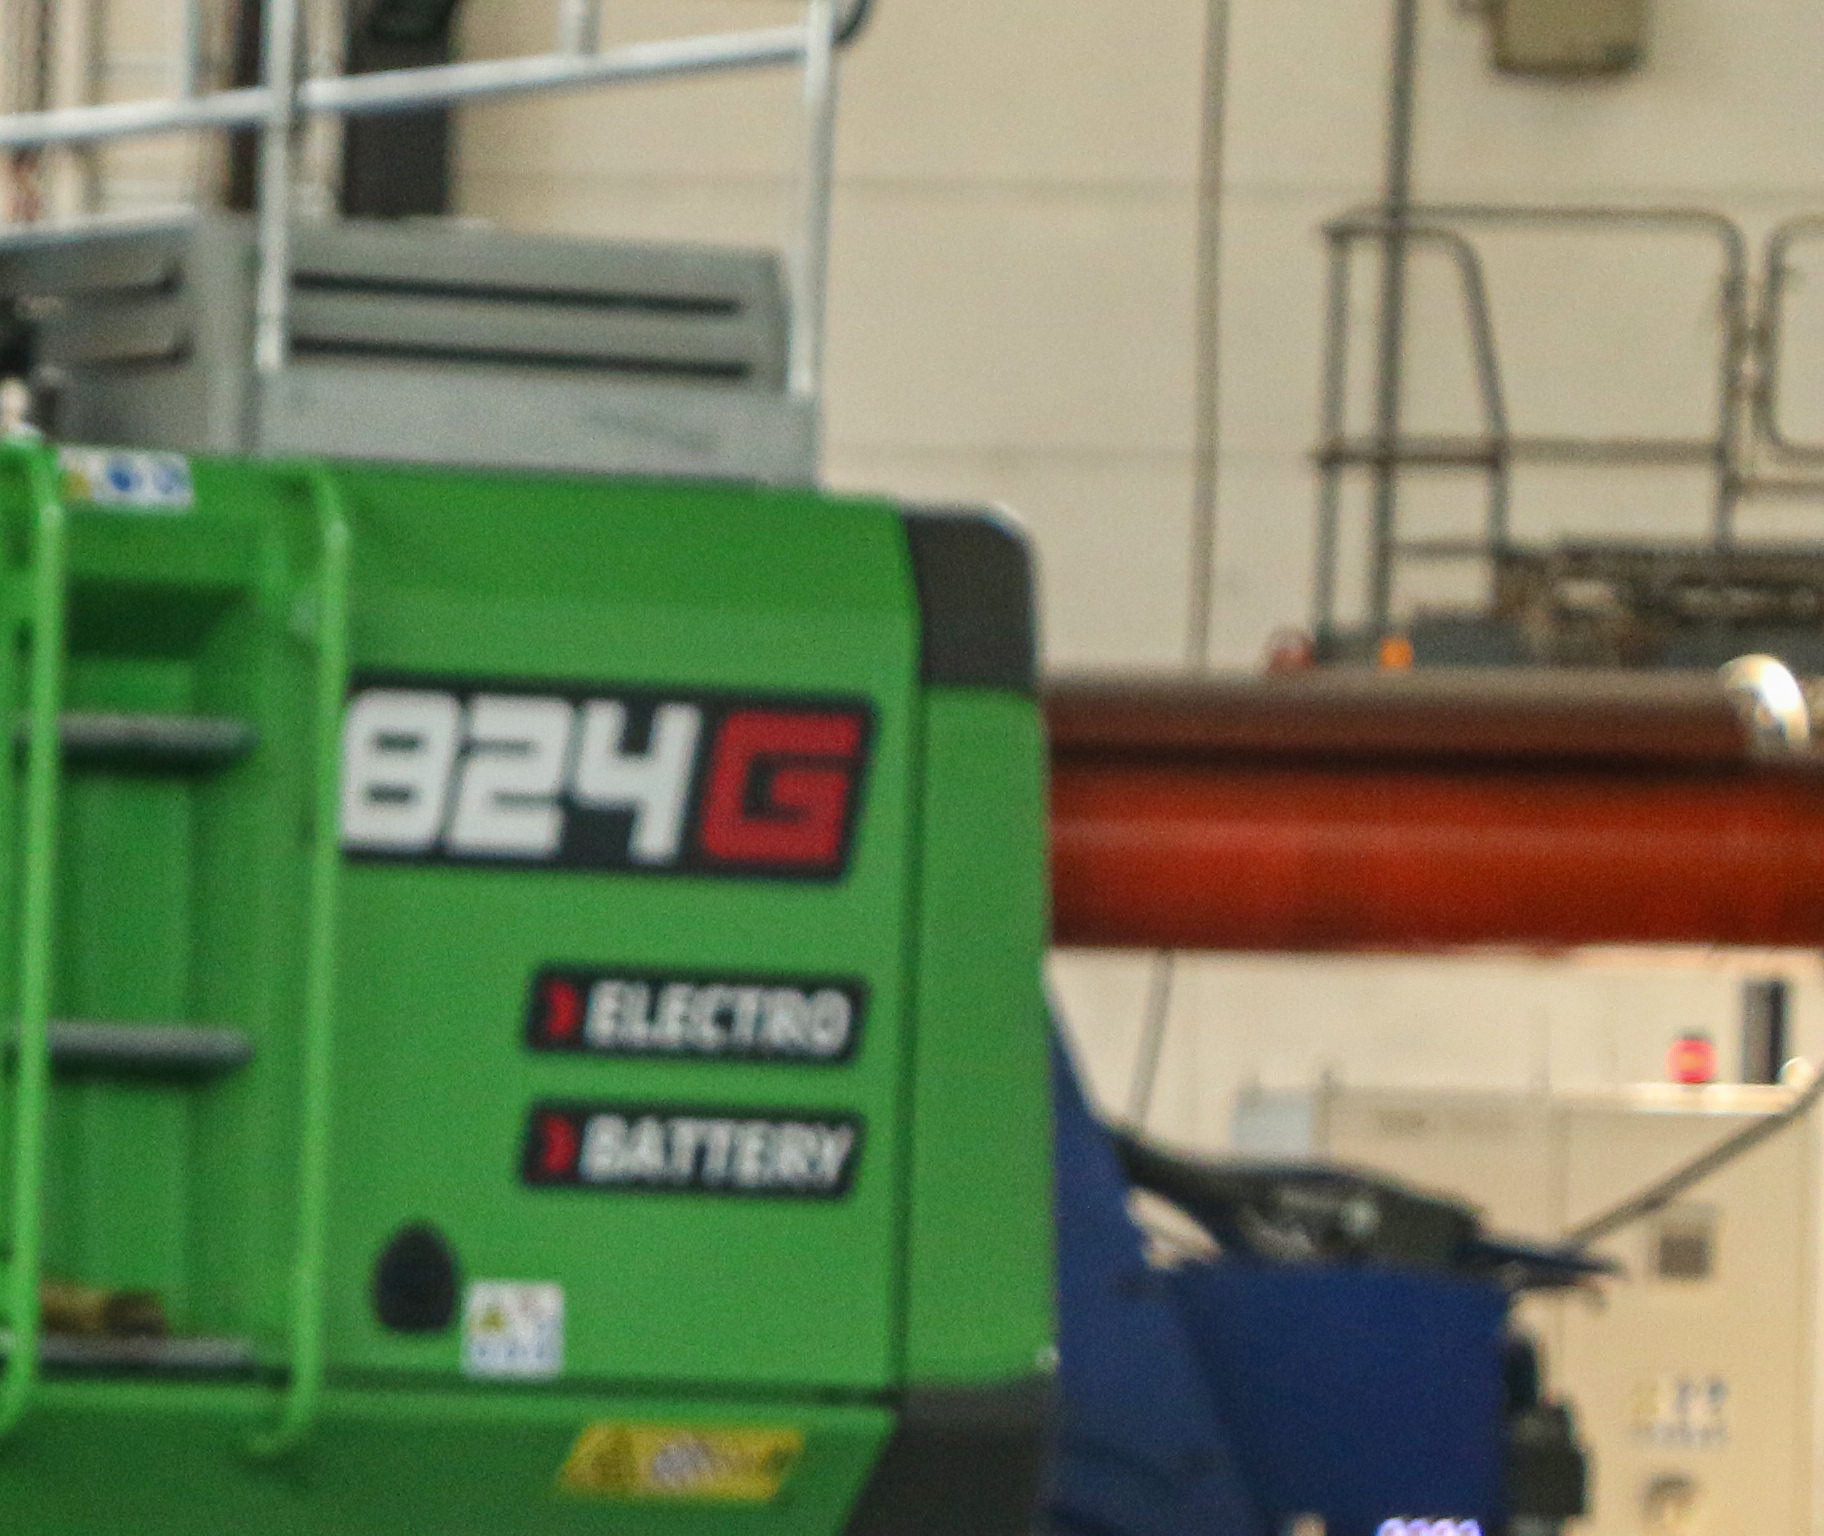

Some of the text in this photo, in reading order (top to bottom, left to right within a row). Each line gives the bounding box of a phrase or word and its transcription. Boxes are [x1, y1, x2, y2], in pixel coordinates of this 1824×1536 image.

[340, 689, 862, 865] 824G
[584, 980, 852, 1056] ELECTRO
[580, 1113, 853, 1189] BATTERY
